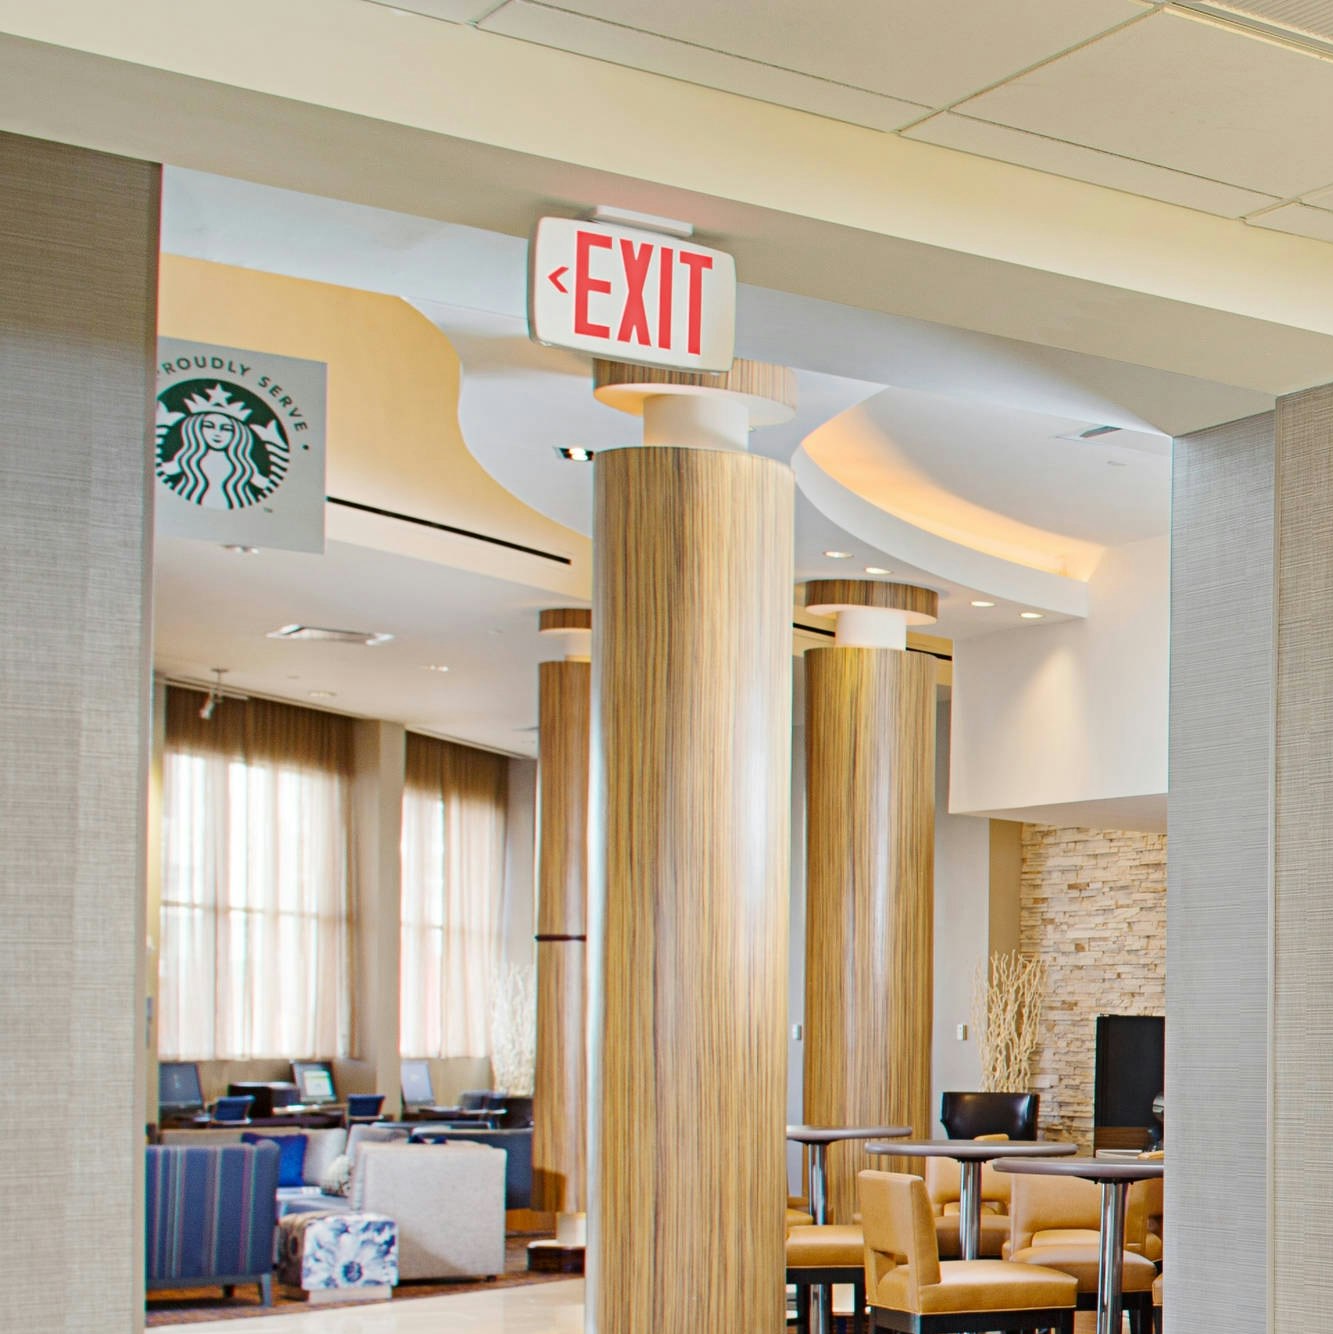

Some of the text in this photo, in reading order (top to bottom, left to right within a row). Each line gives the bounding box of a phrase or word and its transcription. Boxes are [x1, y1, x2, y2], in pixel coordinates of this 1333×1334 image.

[574, 231, 713, 355] EXIT
[157, 356, 308, 431] ROUDLY SERVE
